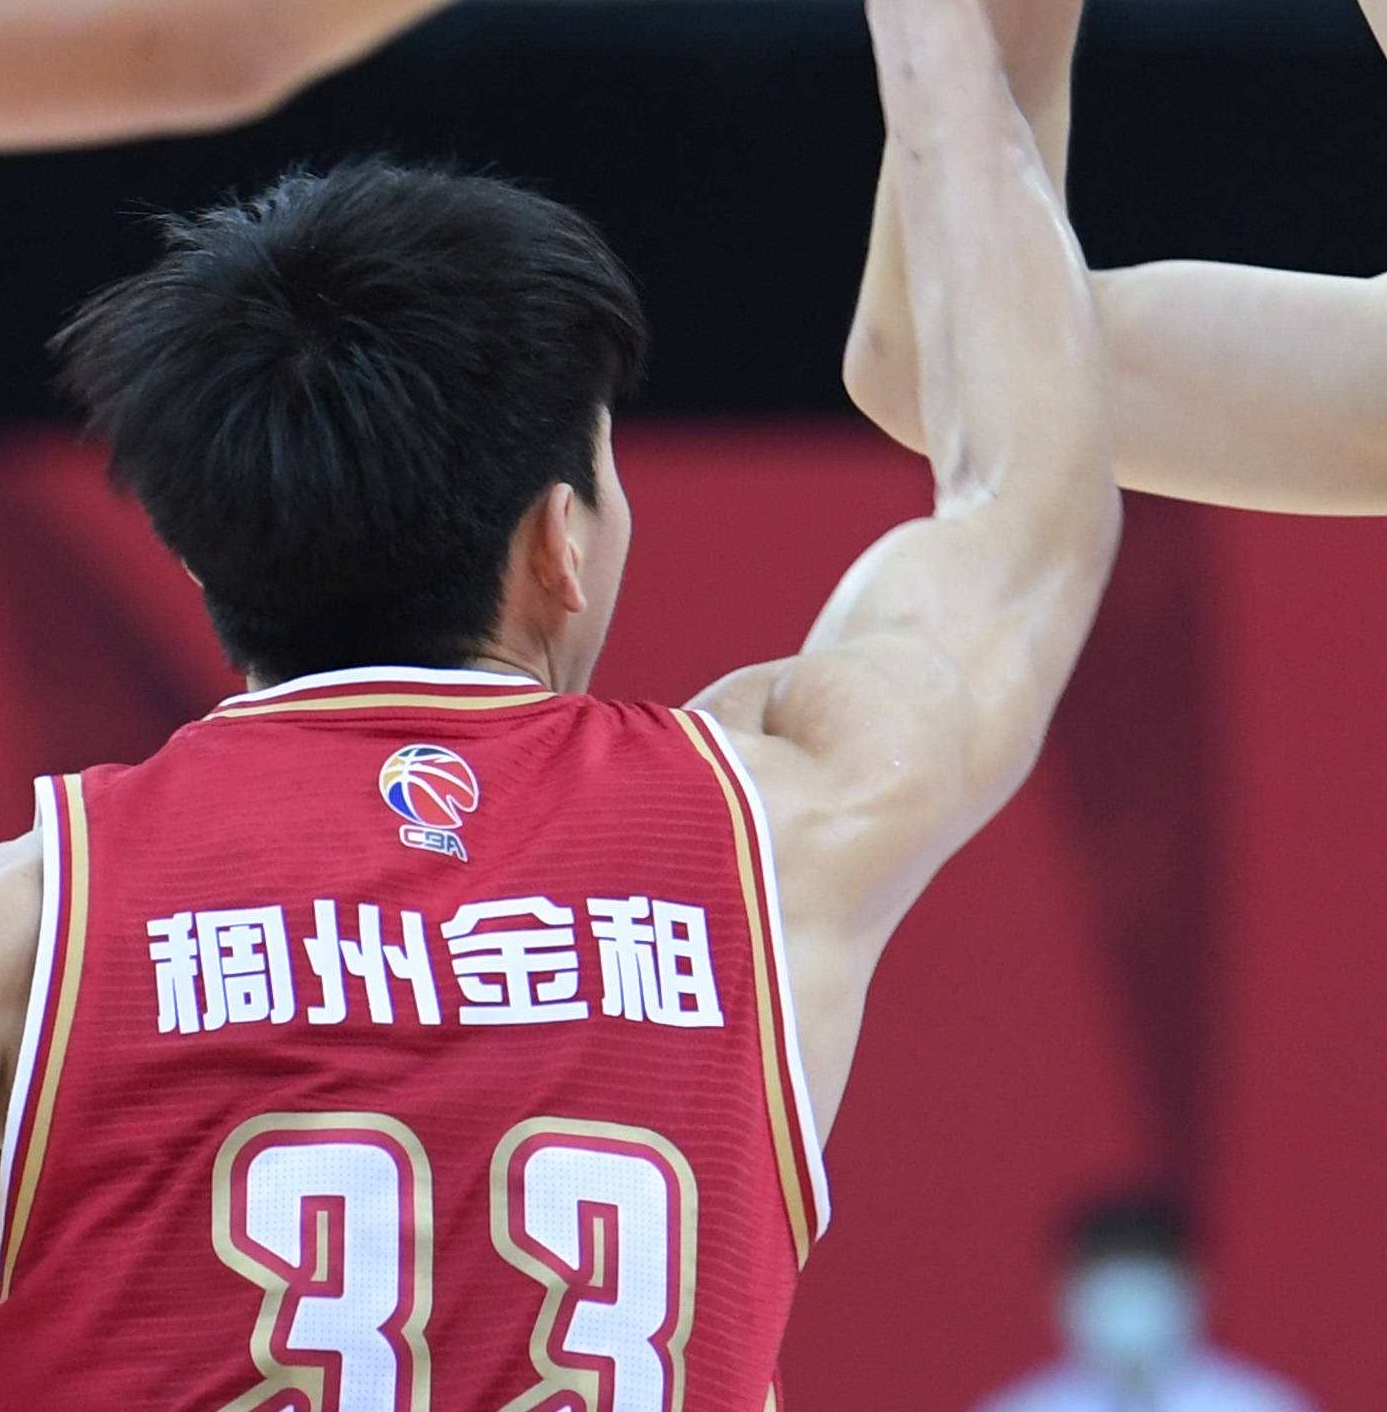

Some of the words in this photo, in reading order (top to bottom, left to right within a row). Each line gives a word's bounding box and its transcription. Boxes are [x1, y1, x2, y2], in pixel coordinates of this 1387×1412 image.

[400, 824, 468, 863] CBA
[147, 895, 725, 1035] 稠州金租
[212, 1111, 699, 1412] 33
